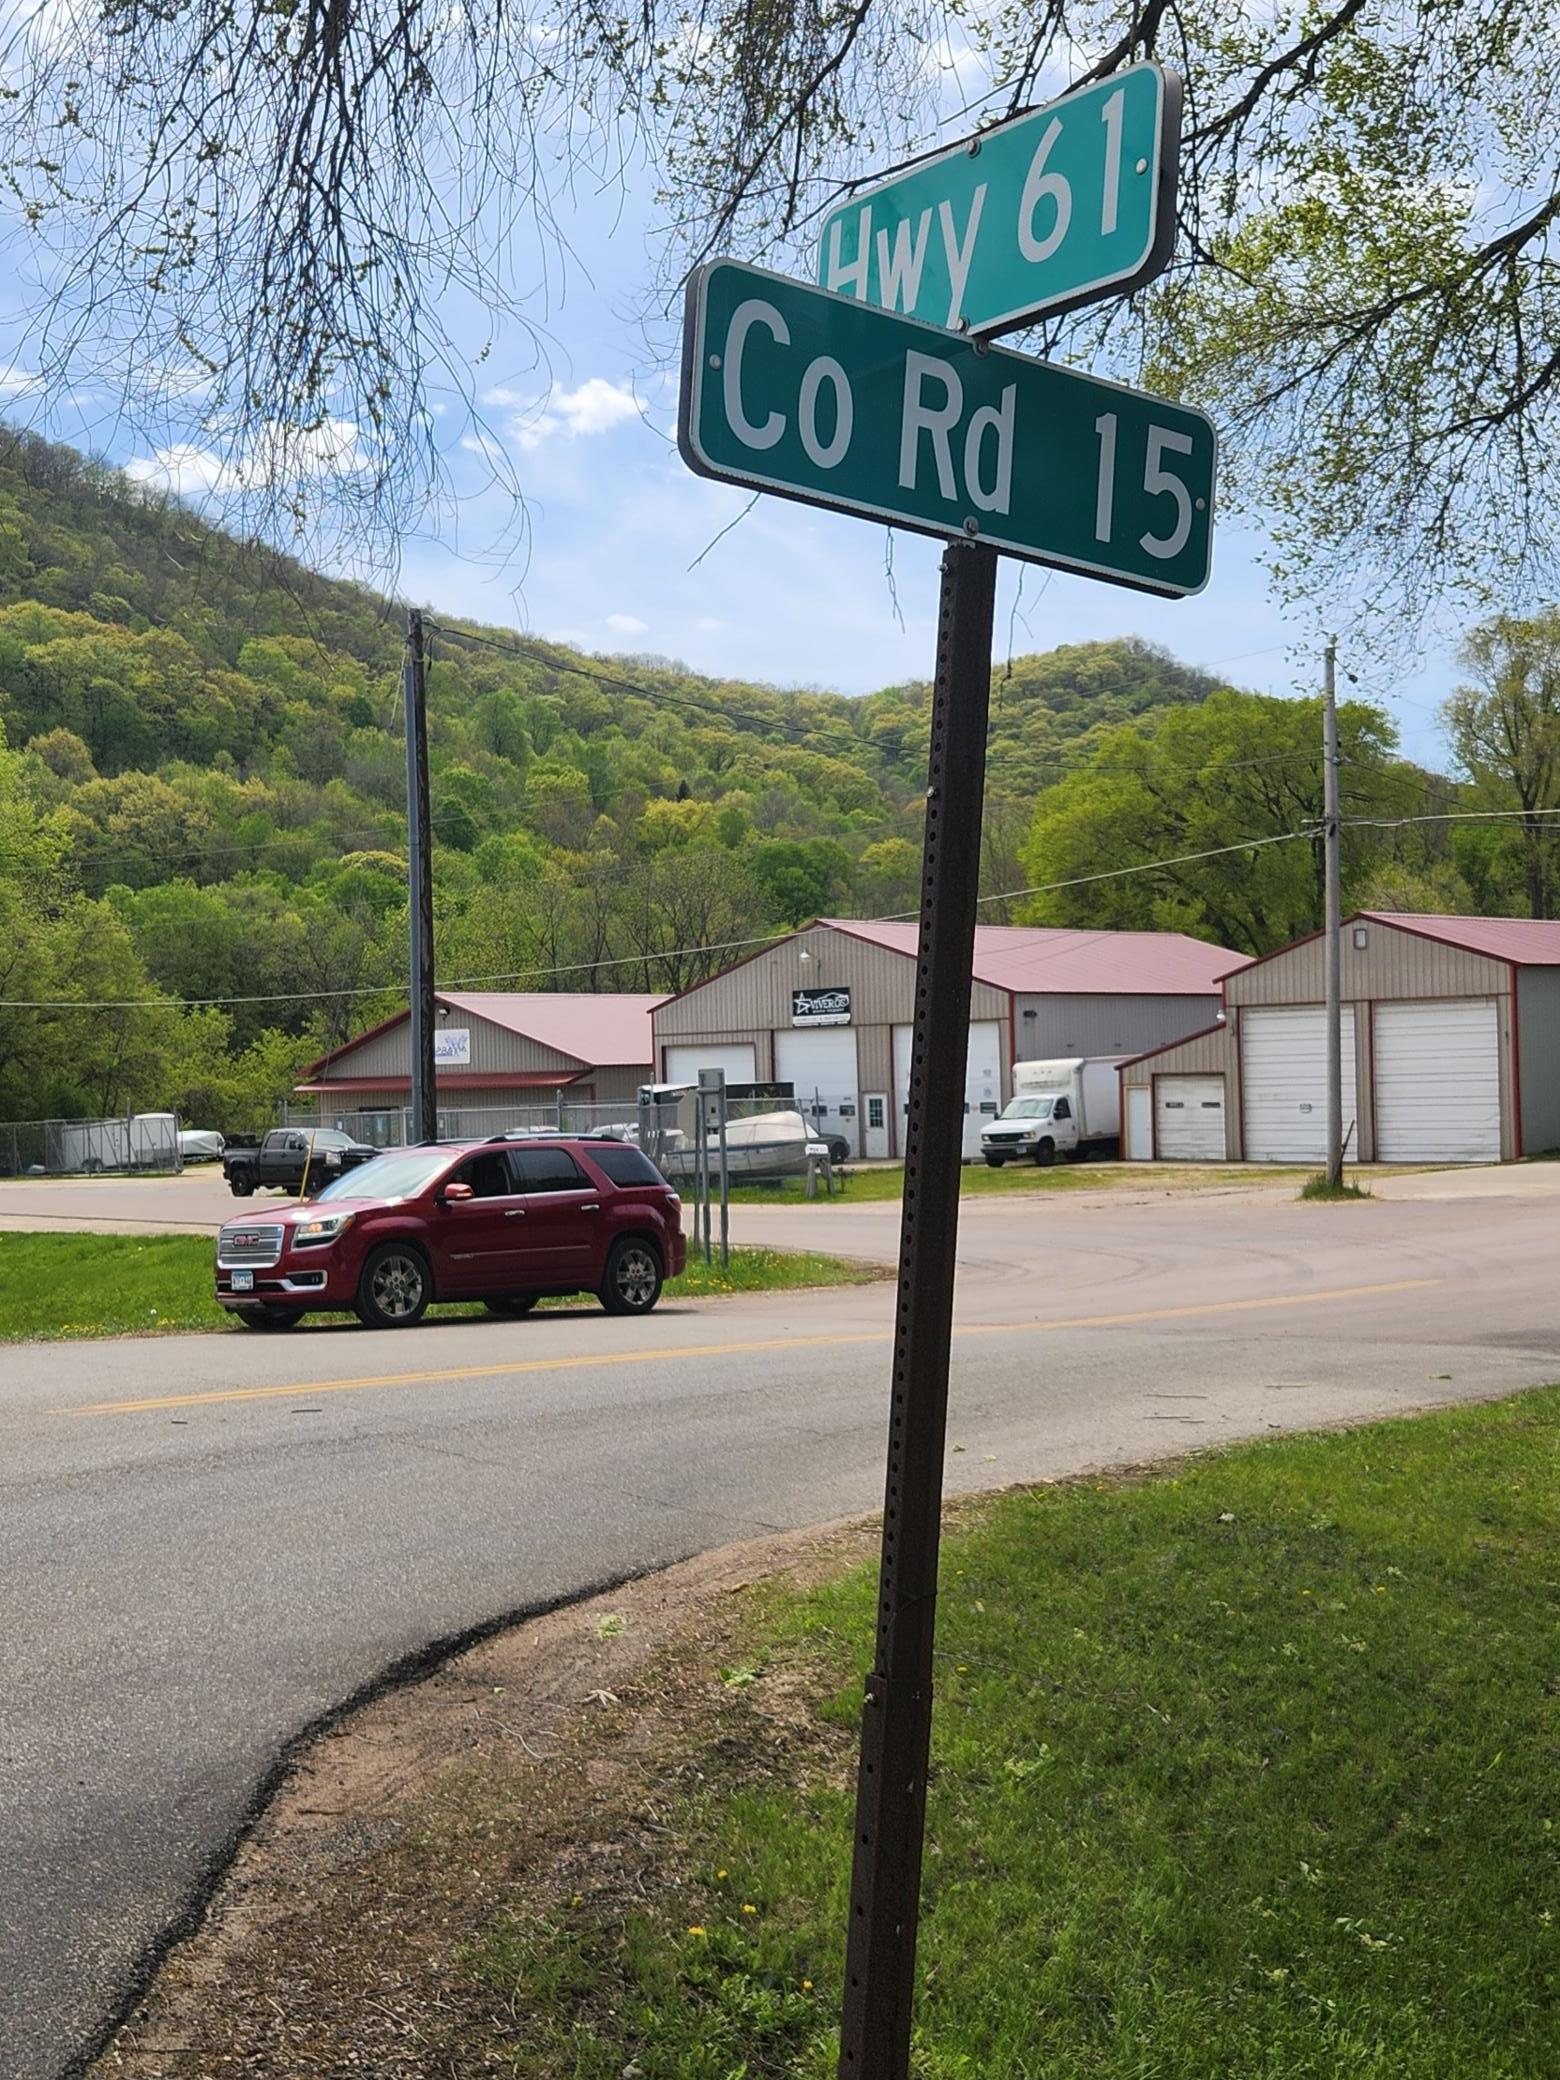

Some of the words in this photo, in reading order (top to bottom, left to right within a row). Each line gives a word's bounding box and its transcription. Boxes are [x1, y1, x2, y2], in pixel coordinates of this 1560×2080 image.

[827, 183, 987, 329] Hwy
[1017, 88, 1125, 263] 61
[723, 298, 854, 469] Co
[898, 350, 1016, 515] Rd
[1094, 412, 1194, 560] 15
